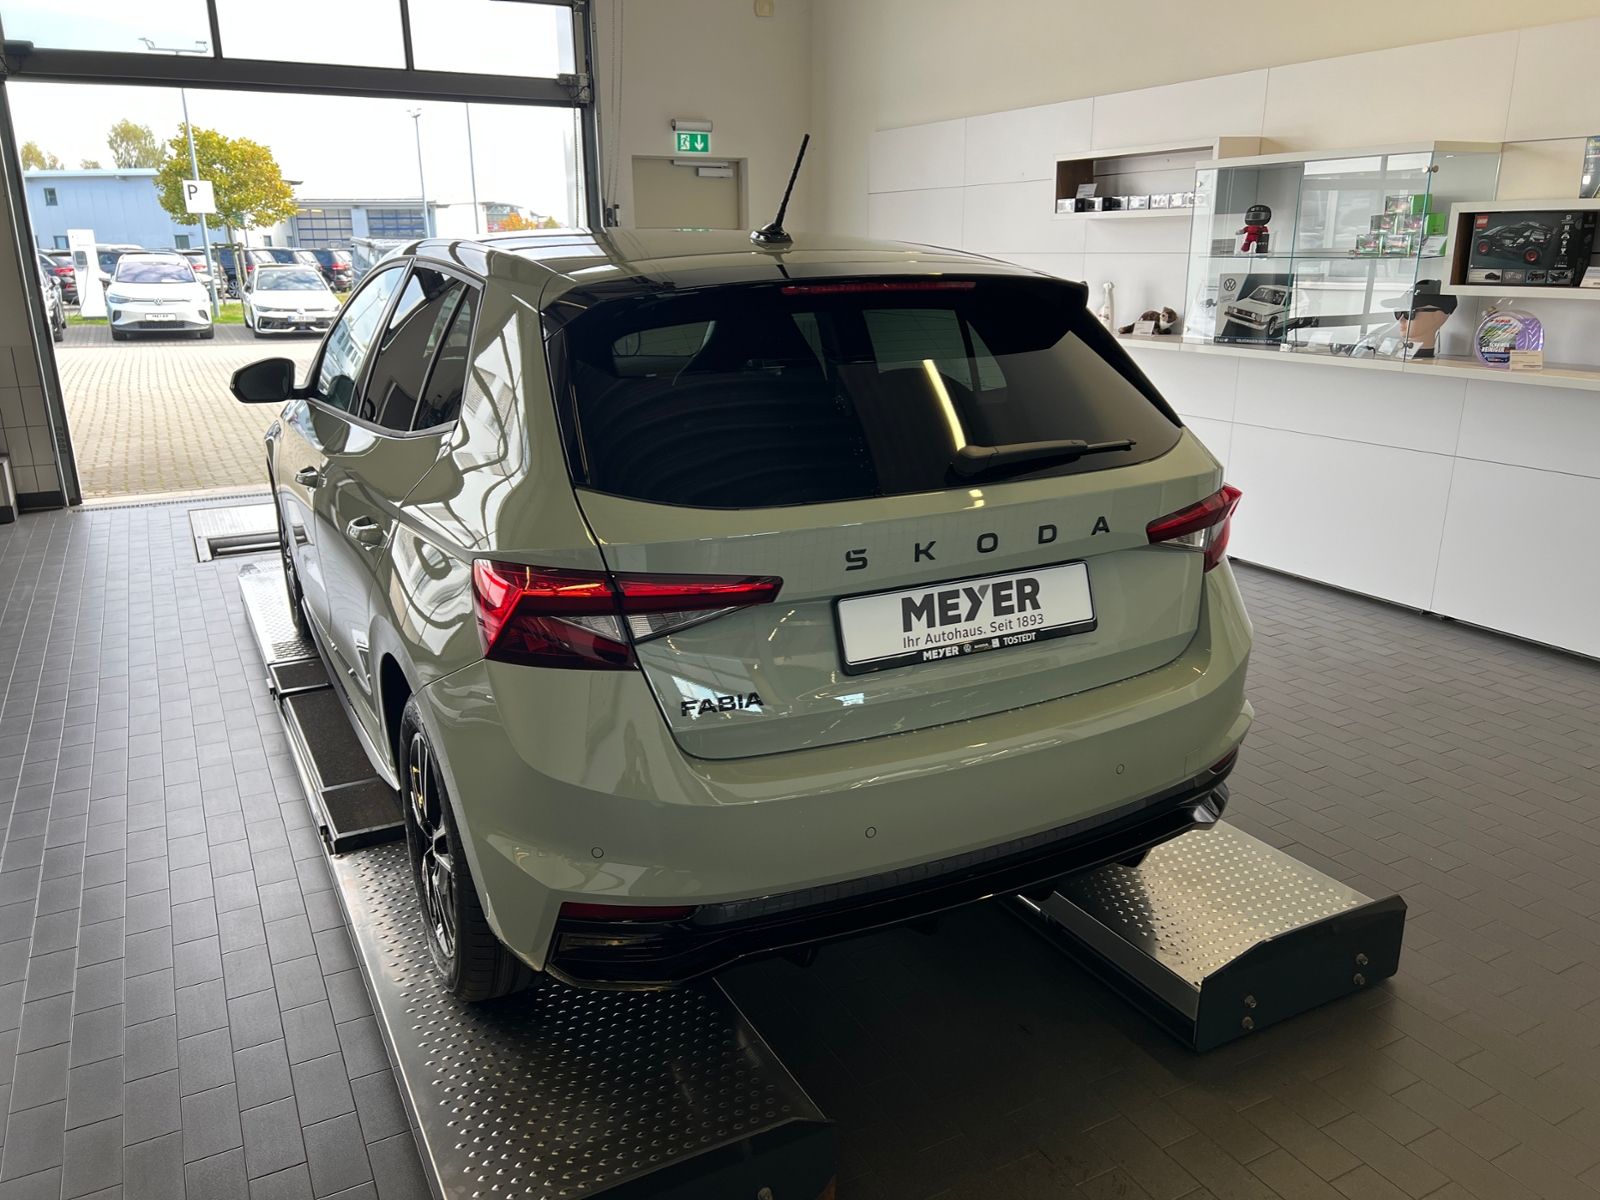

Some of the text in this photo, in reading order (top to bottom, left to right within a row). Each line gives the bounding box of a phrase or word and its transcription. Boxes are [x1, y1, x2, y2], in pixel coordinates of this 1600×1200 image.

[187, 184, 198, 200] P
[845, 516, 1110, 571] SKODA
[901, 577, 1041, 633] MEYER
[903, 614, 1044, 649] Ihr Autohaus. Seit 1893
[923, 645, 959, 661] MEYER
[1003, 632, 1037, 645] TOSTEDT
[681, 692, 764, 716] FABIA
